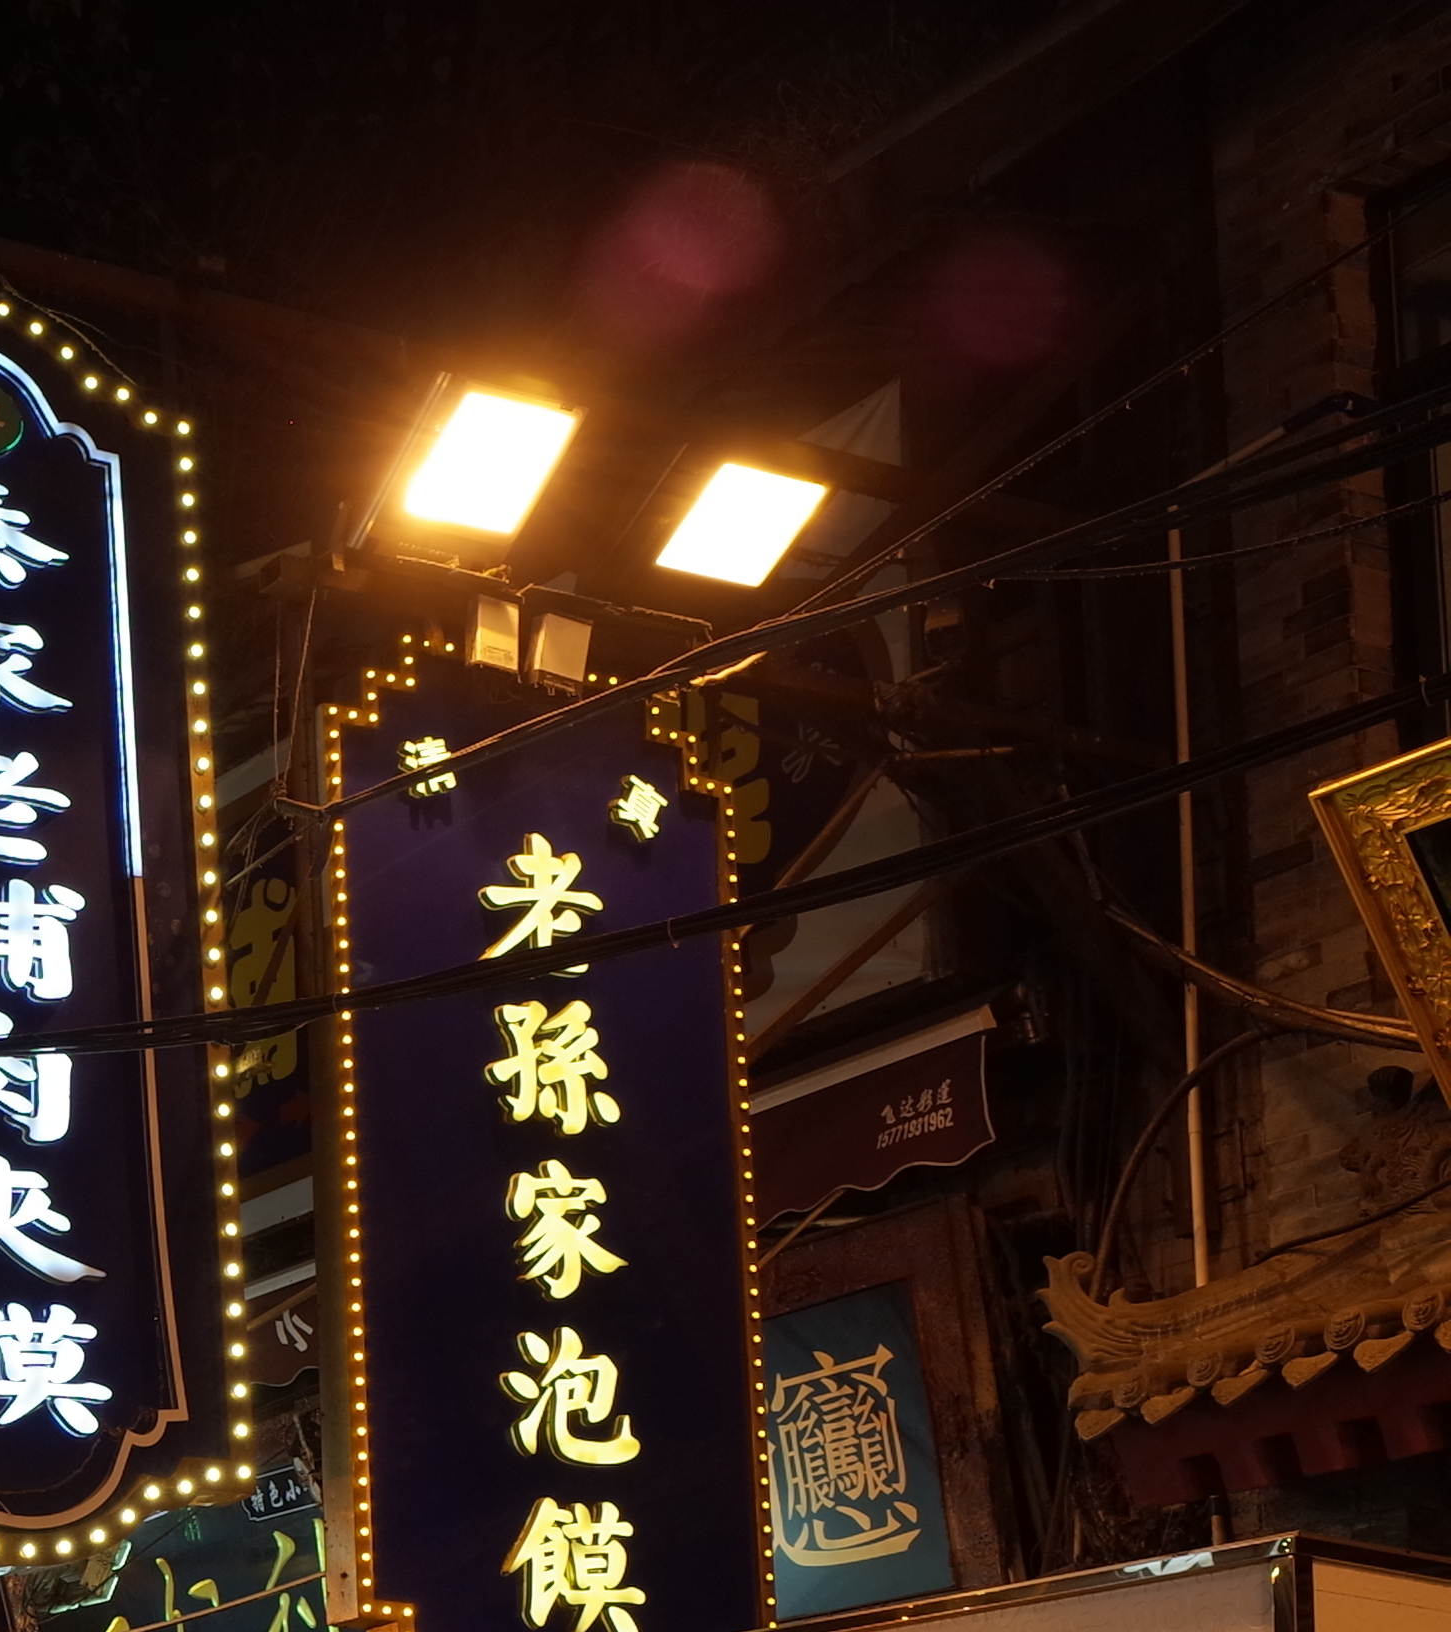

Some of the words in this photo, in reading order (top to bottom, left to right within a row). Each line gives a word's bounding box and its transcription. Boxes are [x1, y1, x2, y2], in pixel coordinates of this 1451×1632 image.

[611, 773, 669, 843] 真
[876, 1106, 954, 1150] 15771931962
[251, 1478, 308, 1513] 特色小
